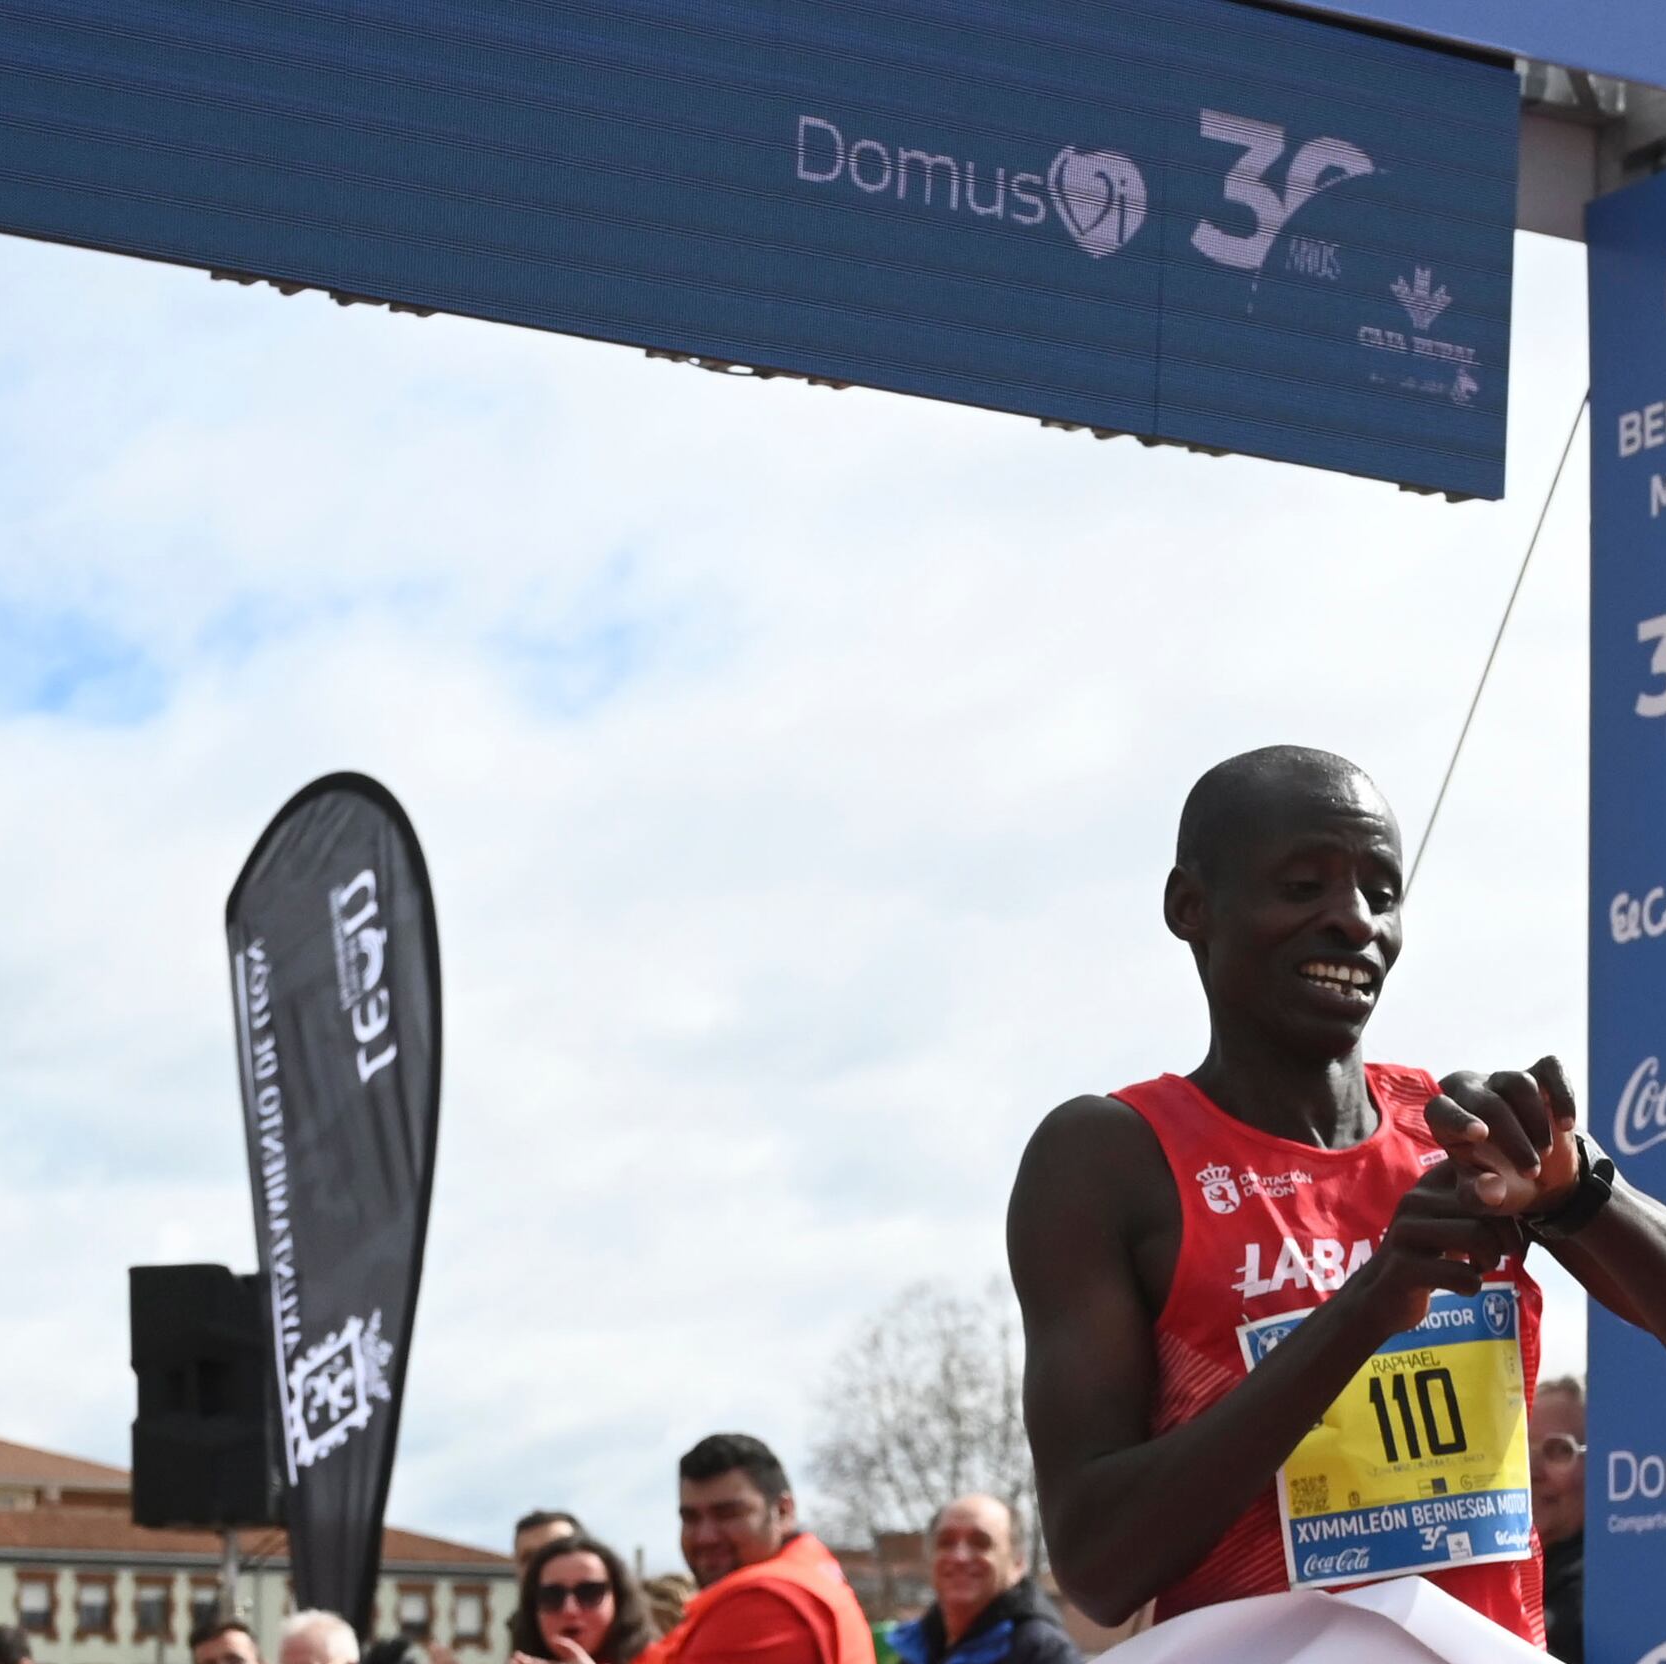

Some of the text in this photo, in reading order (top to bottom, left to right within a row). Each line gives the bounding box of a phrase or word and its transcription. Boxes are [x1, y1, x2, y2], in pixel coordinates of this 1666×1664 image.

[1610, 892, 1641, 943] El
[1371, 1351, 1441, 1374] RAPHAEL
[1369, 1367, 1467, 1464] 110
[1295, 1492, 1527, 1545] XVMMLEÓN BERNESGA MOTOR
